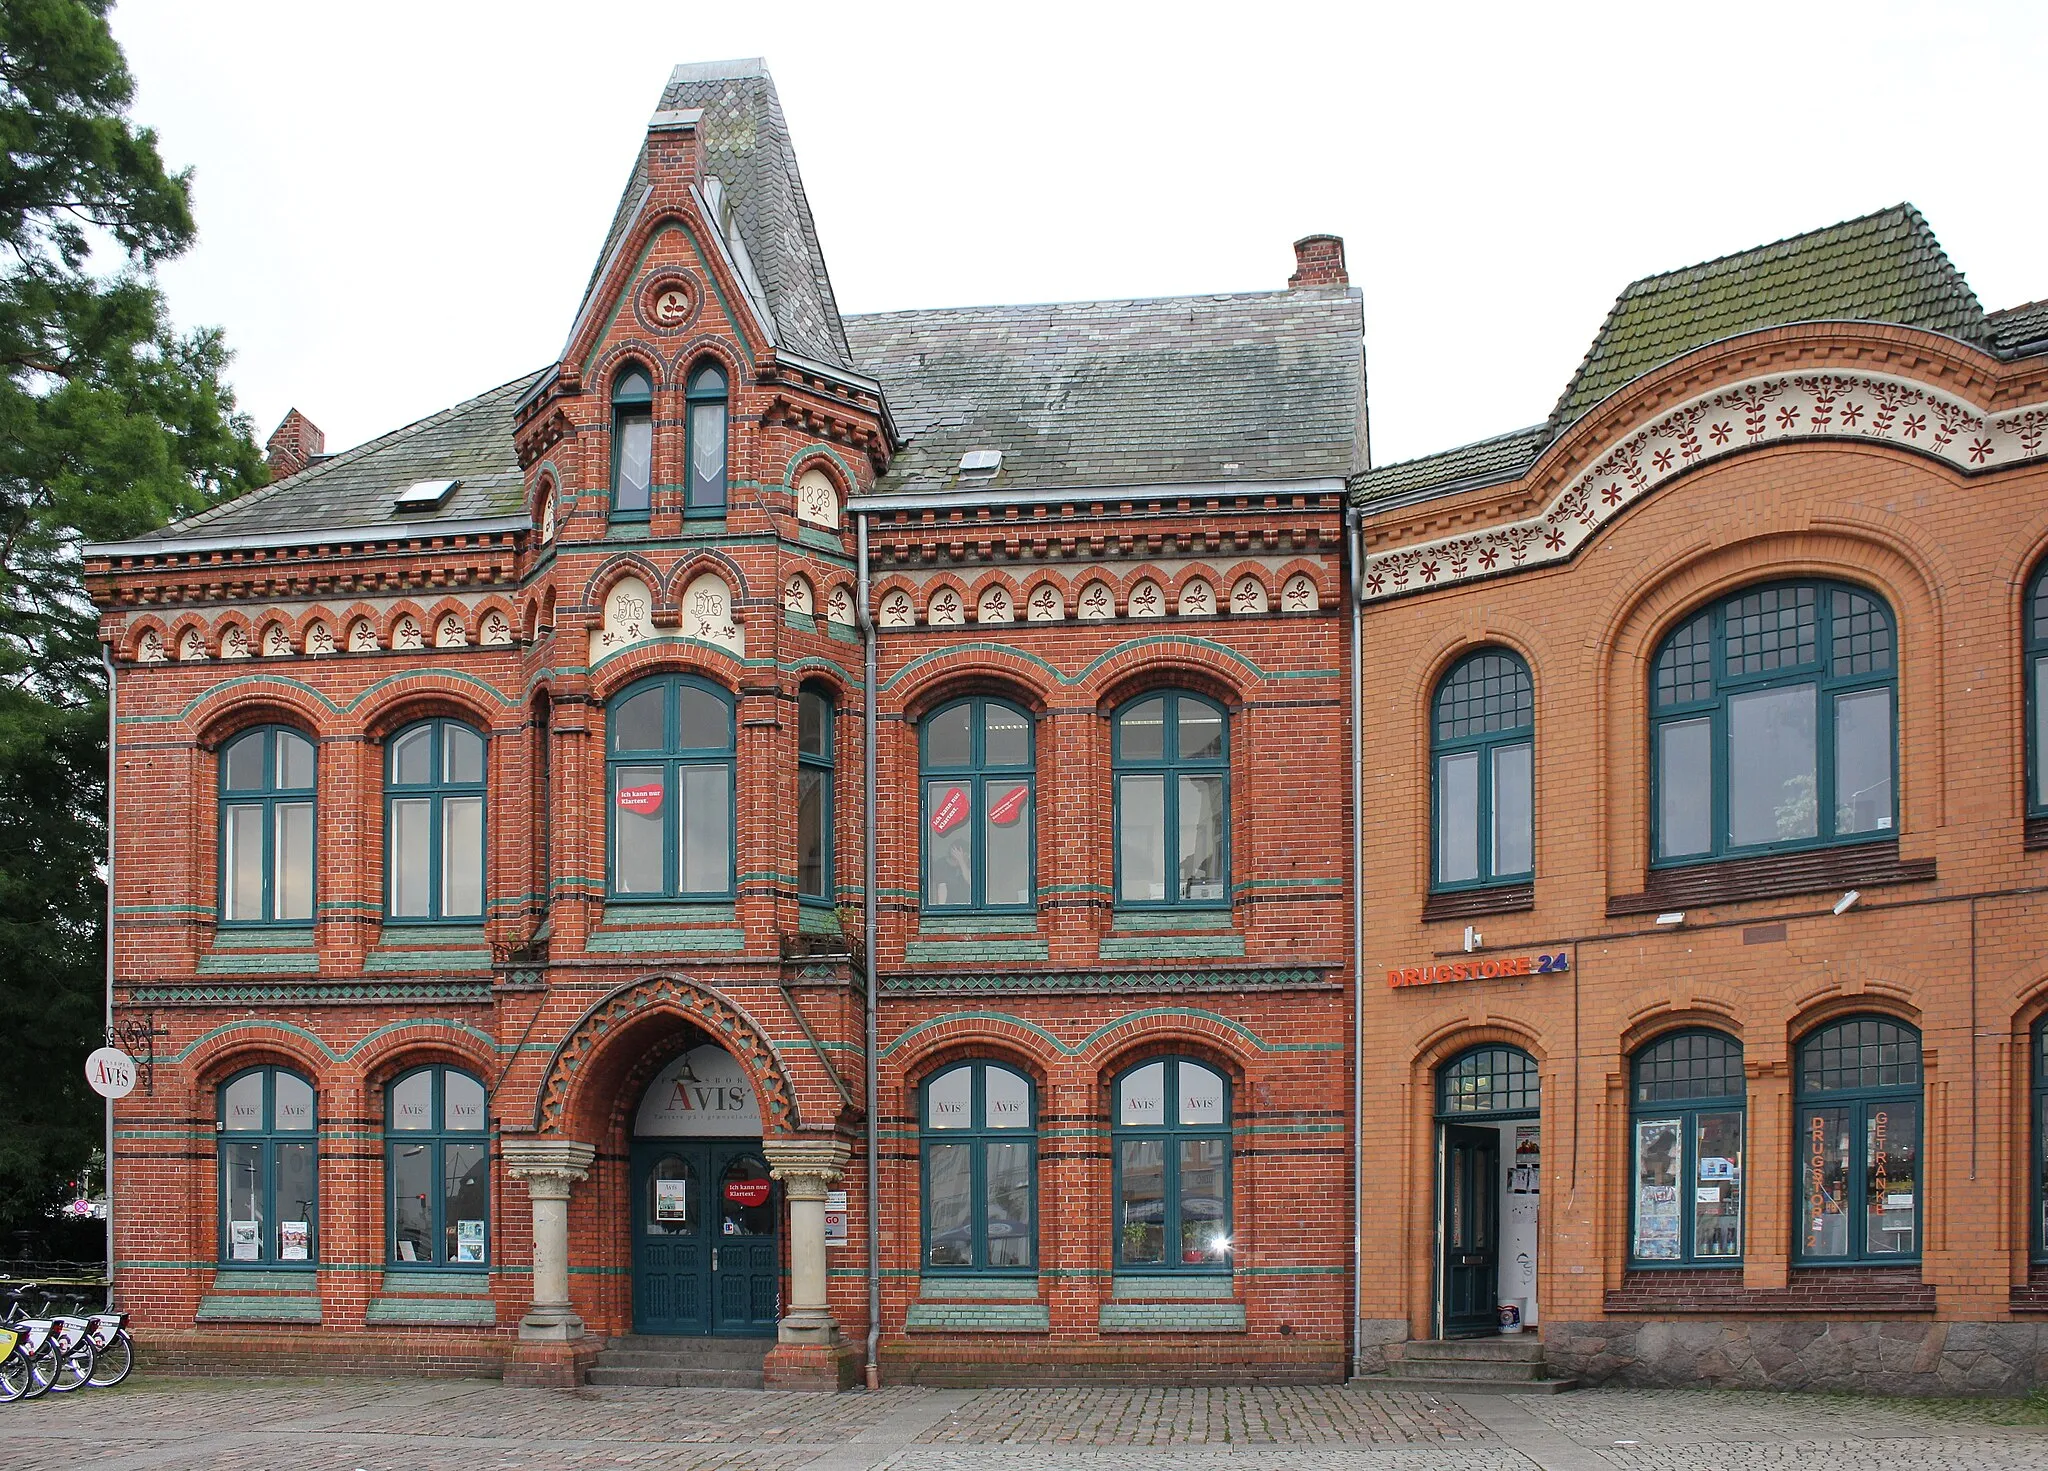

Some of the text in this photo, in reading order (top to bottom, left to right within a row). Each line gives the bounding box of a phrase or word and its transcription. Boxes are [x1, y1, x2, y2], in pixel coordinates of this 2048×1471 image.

[800, 485, 830, 508] 1883
[933, 791, 961, 826] Ich kann nur
[938, 806, 959, 830] Klartext.
[1387, 952, 1568, 988] DRUGSTORE 24
[93, 1060, 129, 1087] AVIS
[665, 1082, 744, 1111] AVIS
[935, 1102, 961, 1113] AVIS
[993, 1101, 1019, 1112] AVIS
[1128, 1098, 1154, 1109] AVIS
[1187, 1097, 1213, 1108] AVIS
[233, 1105, 256, 1115] AVIS
[283, 1105, 305, 1115] AVIS
[400, 1104, 423, 1115] AVIS
[453, 1104, 476, 1115] AVIS
[1875, 1112, 1888, 1216] GETRÄNKE
